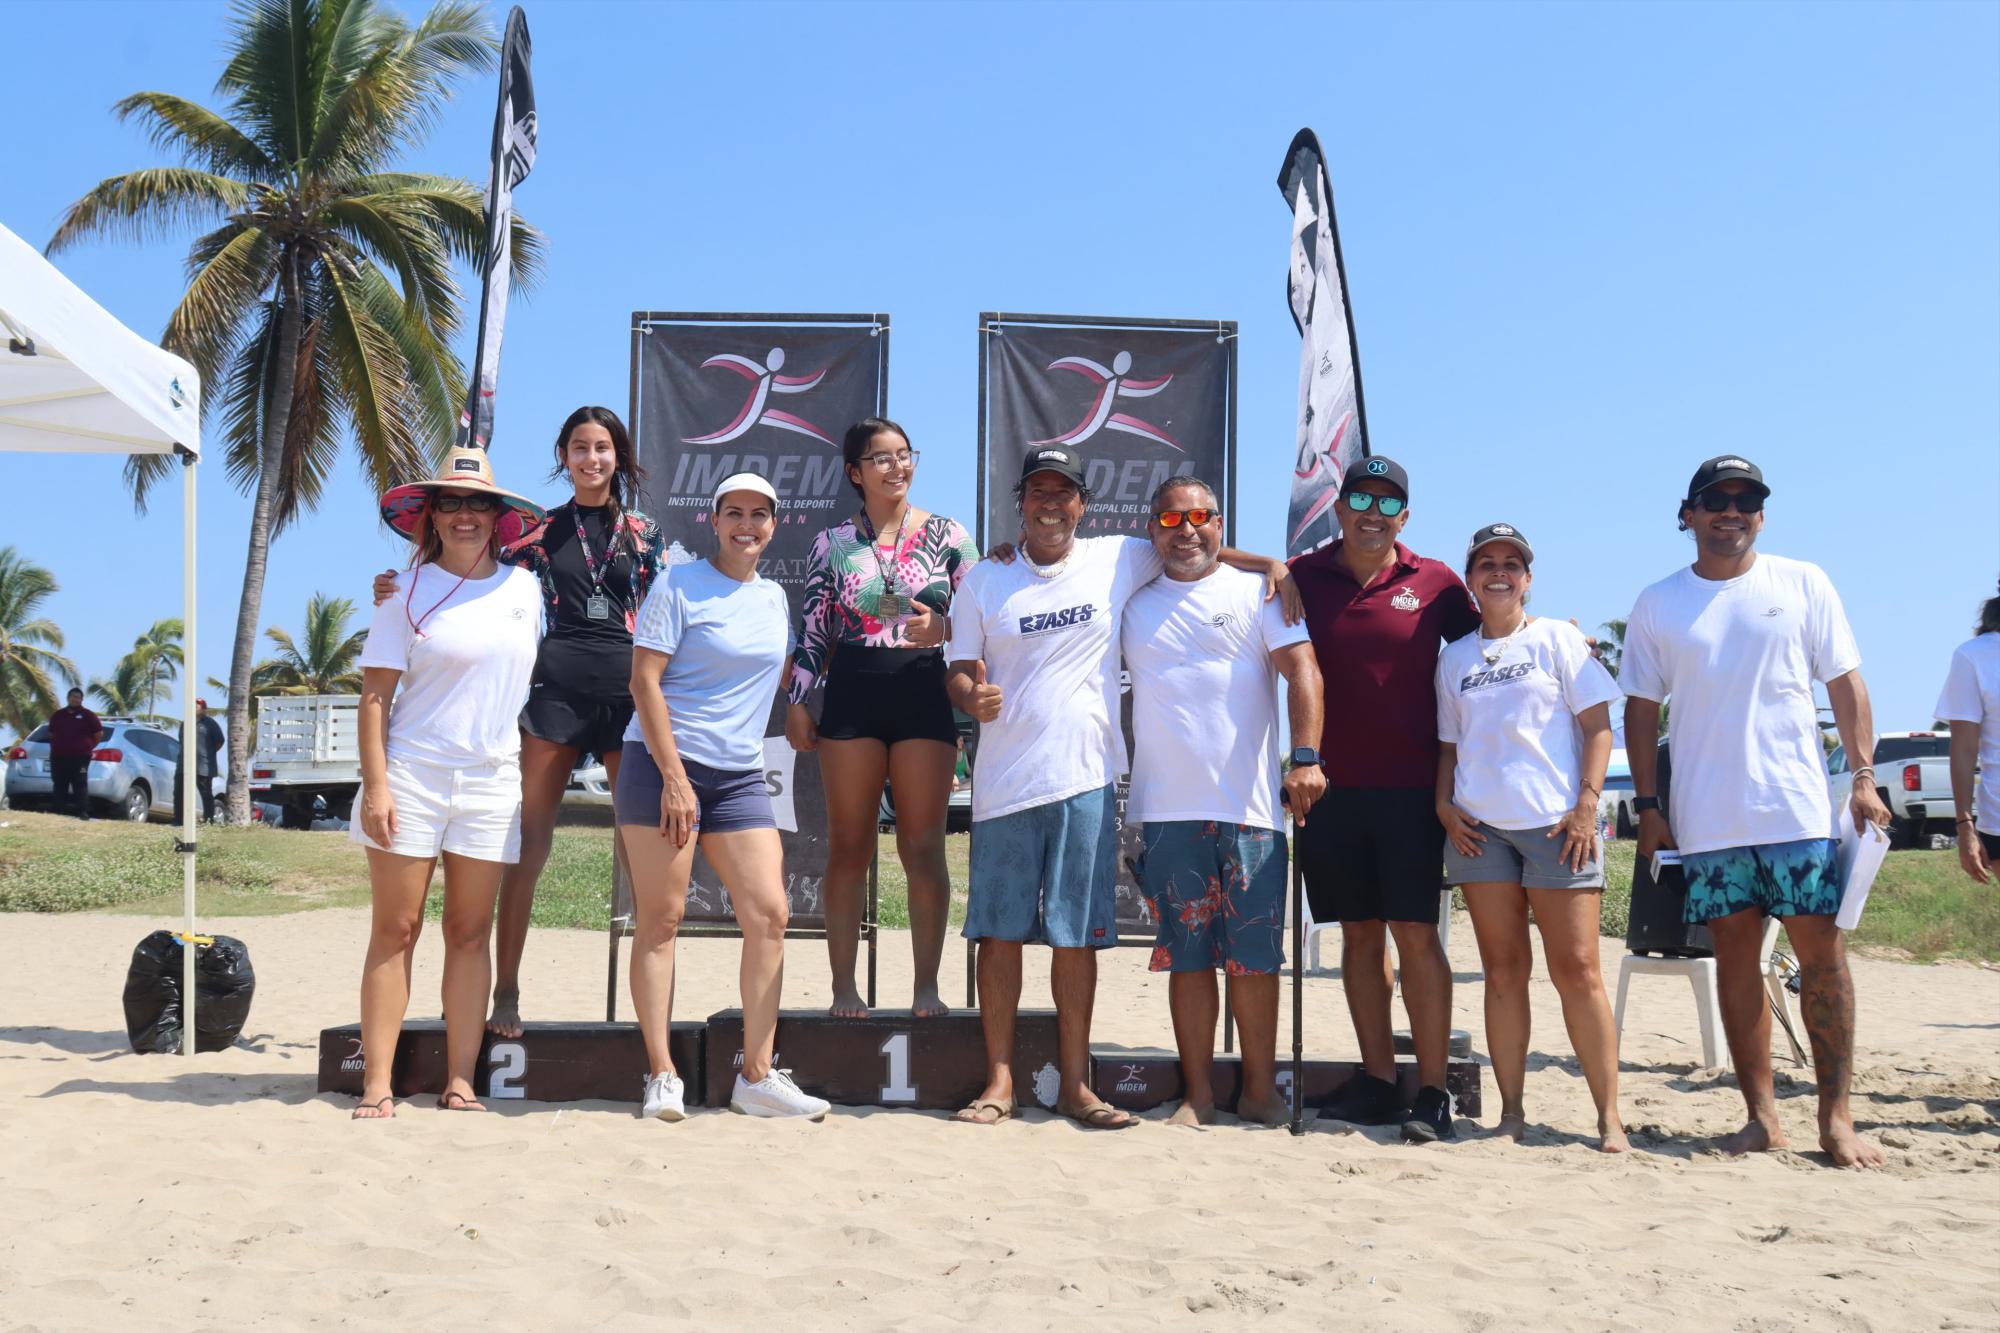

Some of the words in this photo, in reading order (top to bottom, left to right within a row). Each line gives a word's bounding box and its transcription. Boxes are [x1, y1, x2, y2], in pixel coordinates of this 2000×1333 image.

[1085, 458, 1196, 501] DEM
[793, 499, 837, 510] DEPORTE
[1121, 504, 1139, 514] DEL
[1391, 595, 1420, 609] IMDEM
[341, 1059, 367, 1070] IMD
[882, 1035, 916, 1101] 1
[489, 1043, 527, 1099] 2
[1116, 1083, 1148, 1092] IMDEM
